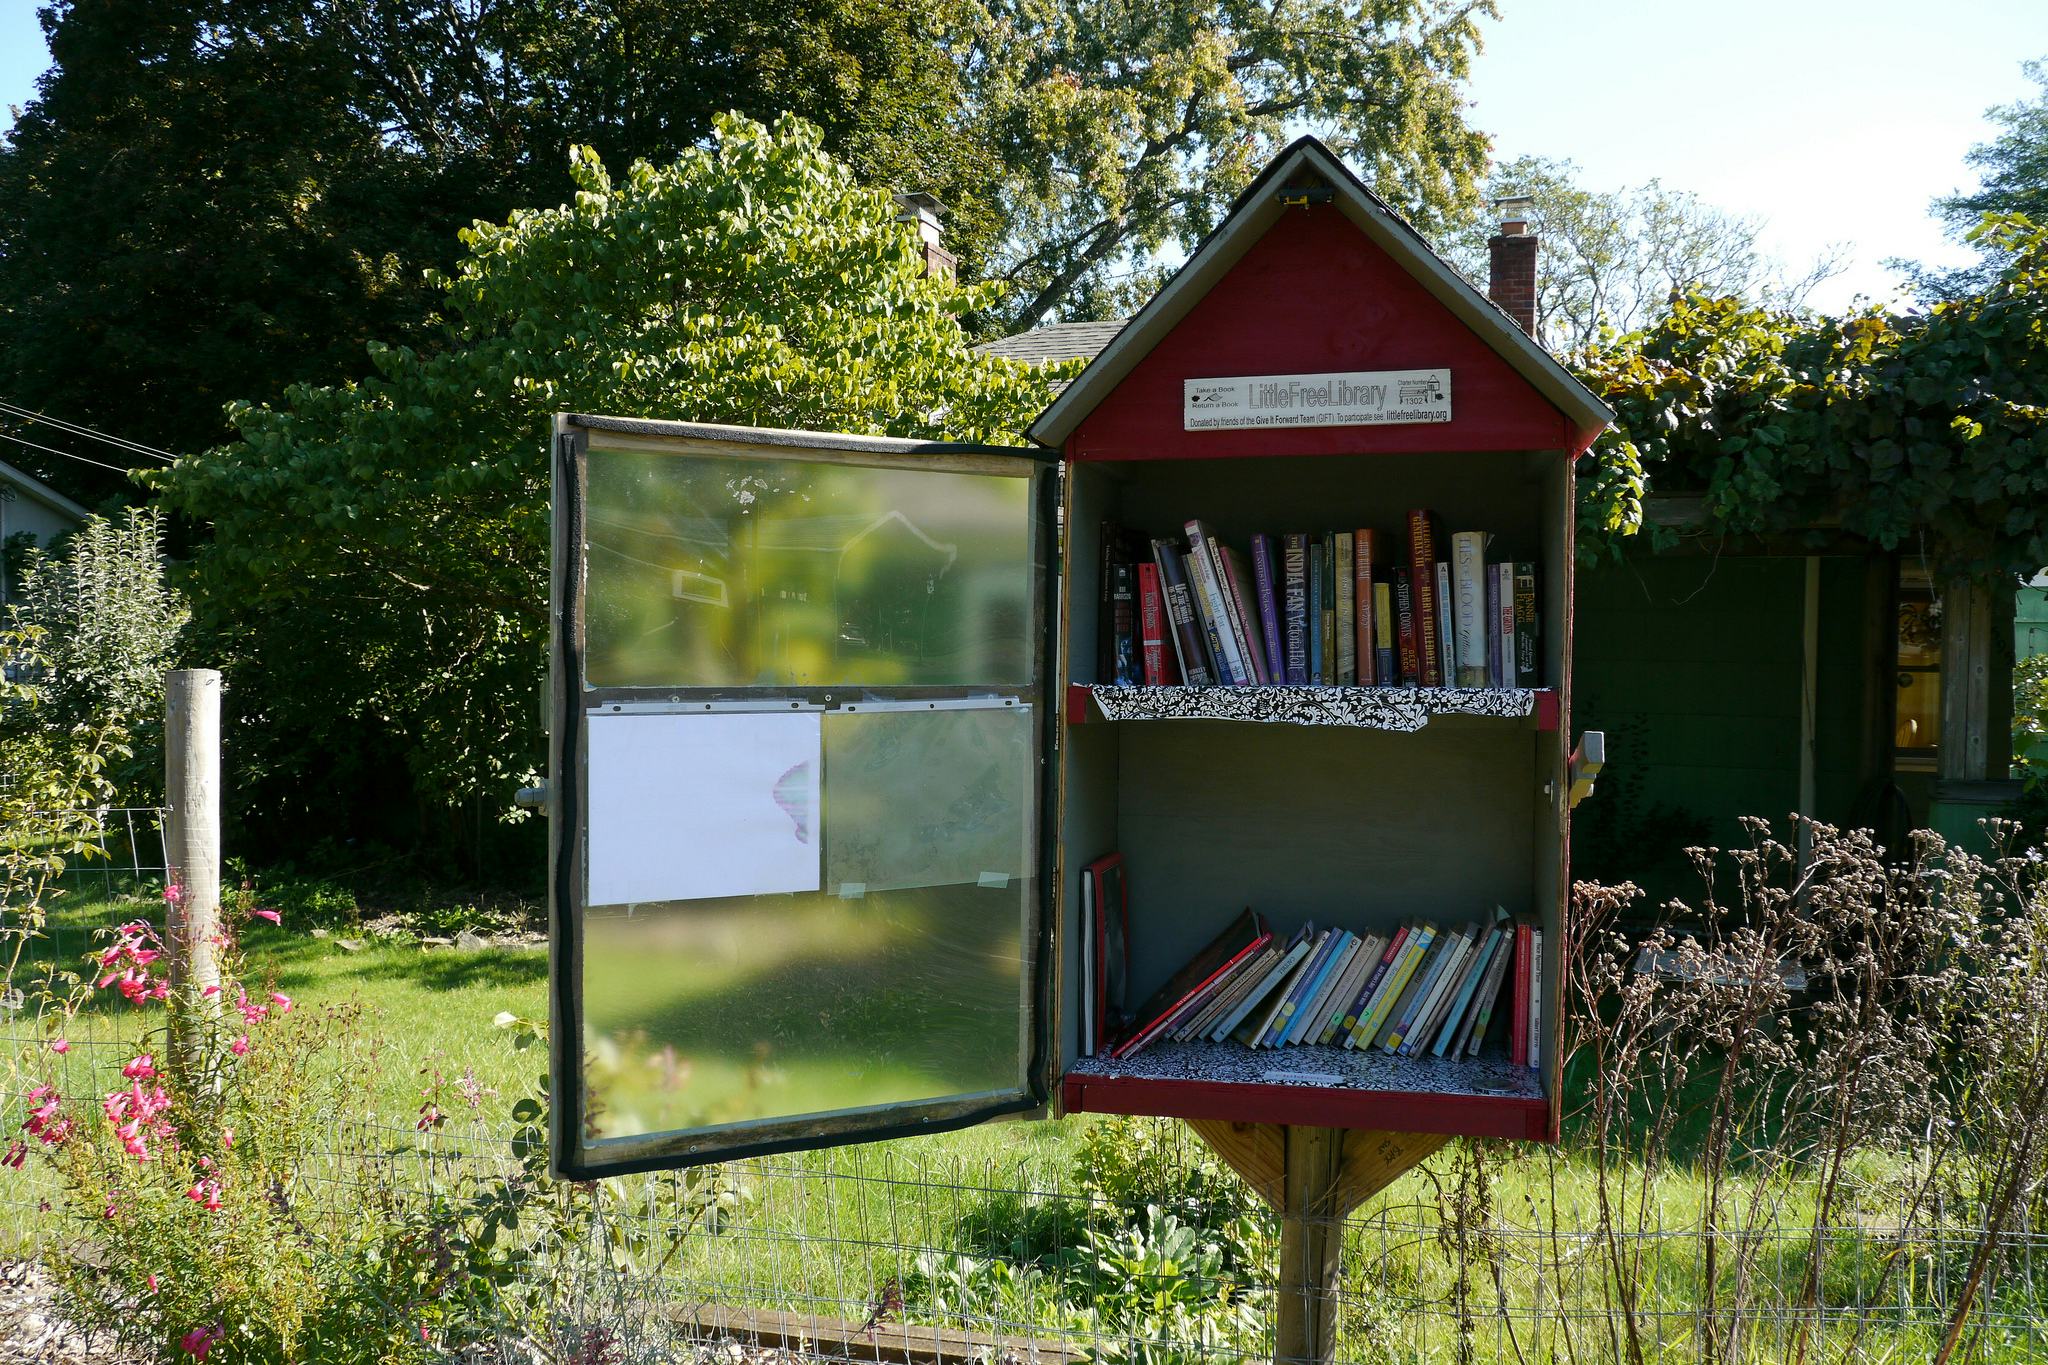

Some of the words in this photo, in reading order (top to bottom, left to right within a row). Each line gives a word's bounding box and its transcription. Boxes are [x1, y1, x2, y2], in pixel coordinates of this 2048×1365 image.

[1249, 380, 1387, 411] LittleFreeLibrary
[1190, 418, 1213, 427] Donated
[1213, 418, 1220, 428] by
[1220, 416, 1239, 426] friends
[1240, 416, 1245, 425] of
[1245, 416, 1255, 425] the
[1256, 416, 1269, 425] Give
[1275, 414, 1299, 424] Forward
[1300, 414, 1315, 423] Team
[1337, 412, 1344, 422] To
[1344, 412, 1373, 423] participate
[1386, 409, 1447, 421] littlefreelibrary.org
[1412, 516, 1424, 554] GENERALS
[1422, 521, 1433, 562] ALTERNATE
[1415, 557, 1425, 568] III
[1458, 537, 1472, 565] TIES
[1286, 548, 1304, 586] INDIA
[1286, 588, 1305, 612] FAN
[1397, 583, 1411, 612] STEPHEN
[1421, 586, 1433, 613] HARRY
[1460, 579, 1474, 626] BLOOD
[1503, 606, 1513, 615] THE
[1516, 593, 1525, 624] FLAGG
[1525, 593, 1535, 624] FANNIE
[1287, 614, 1307, 649] Victoria
[1399, 612, 1413, 637] COONTS
[1423, 615, 1436, 666] TURTLEDOVE
[1288, 650, 1304, 670] Holt
[1400, 647, 1409, 671] BLACK
[1408, 649, 1417, 669] DEEP
